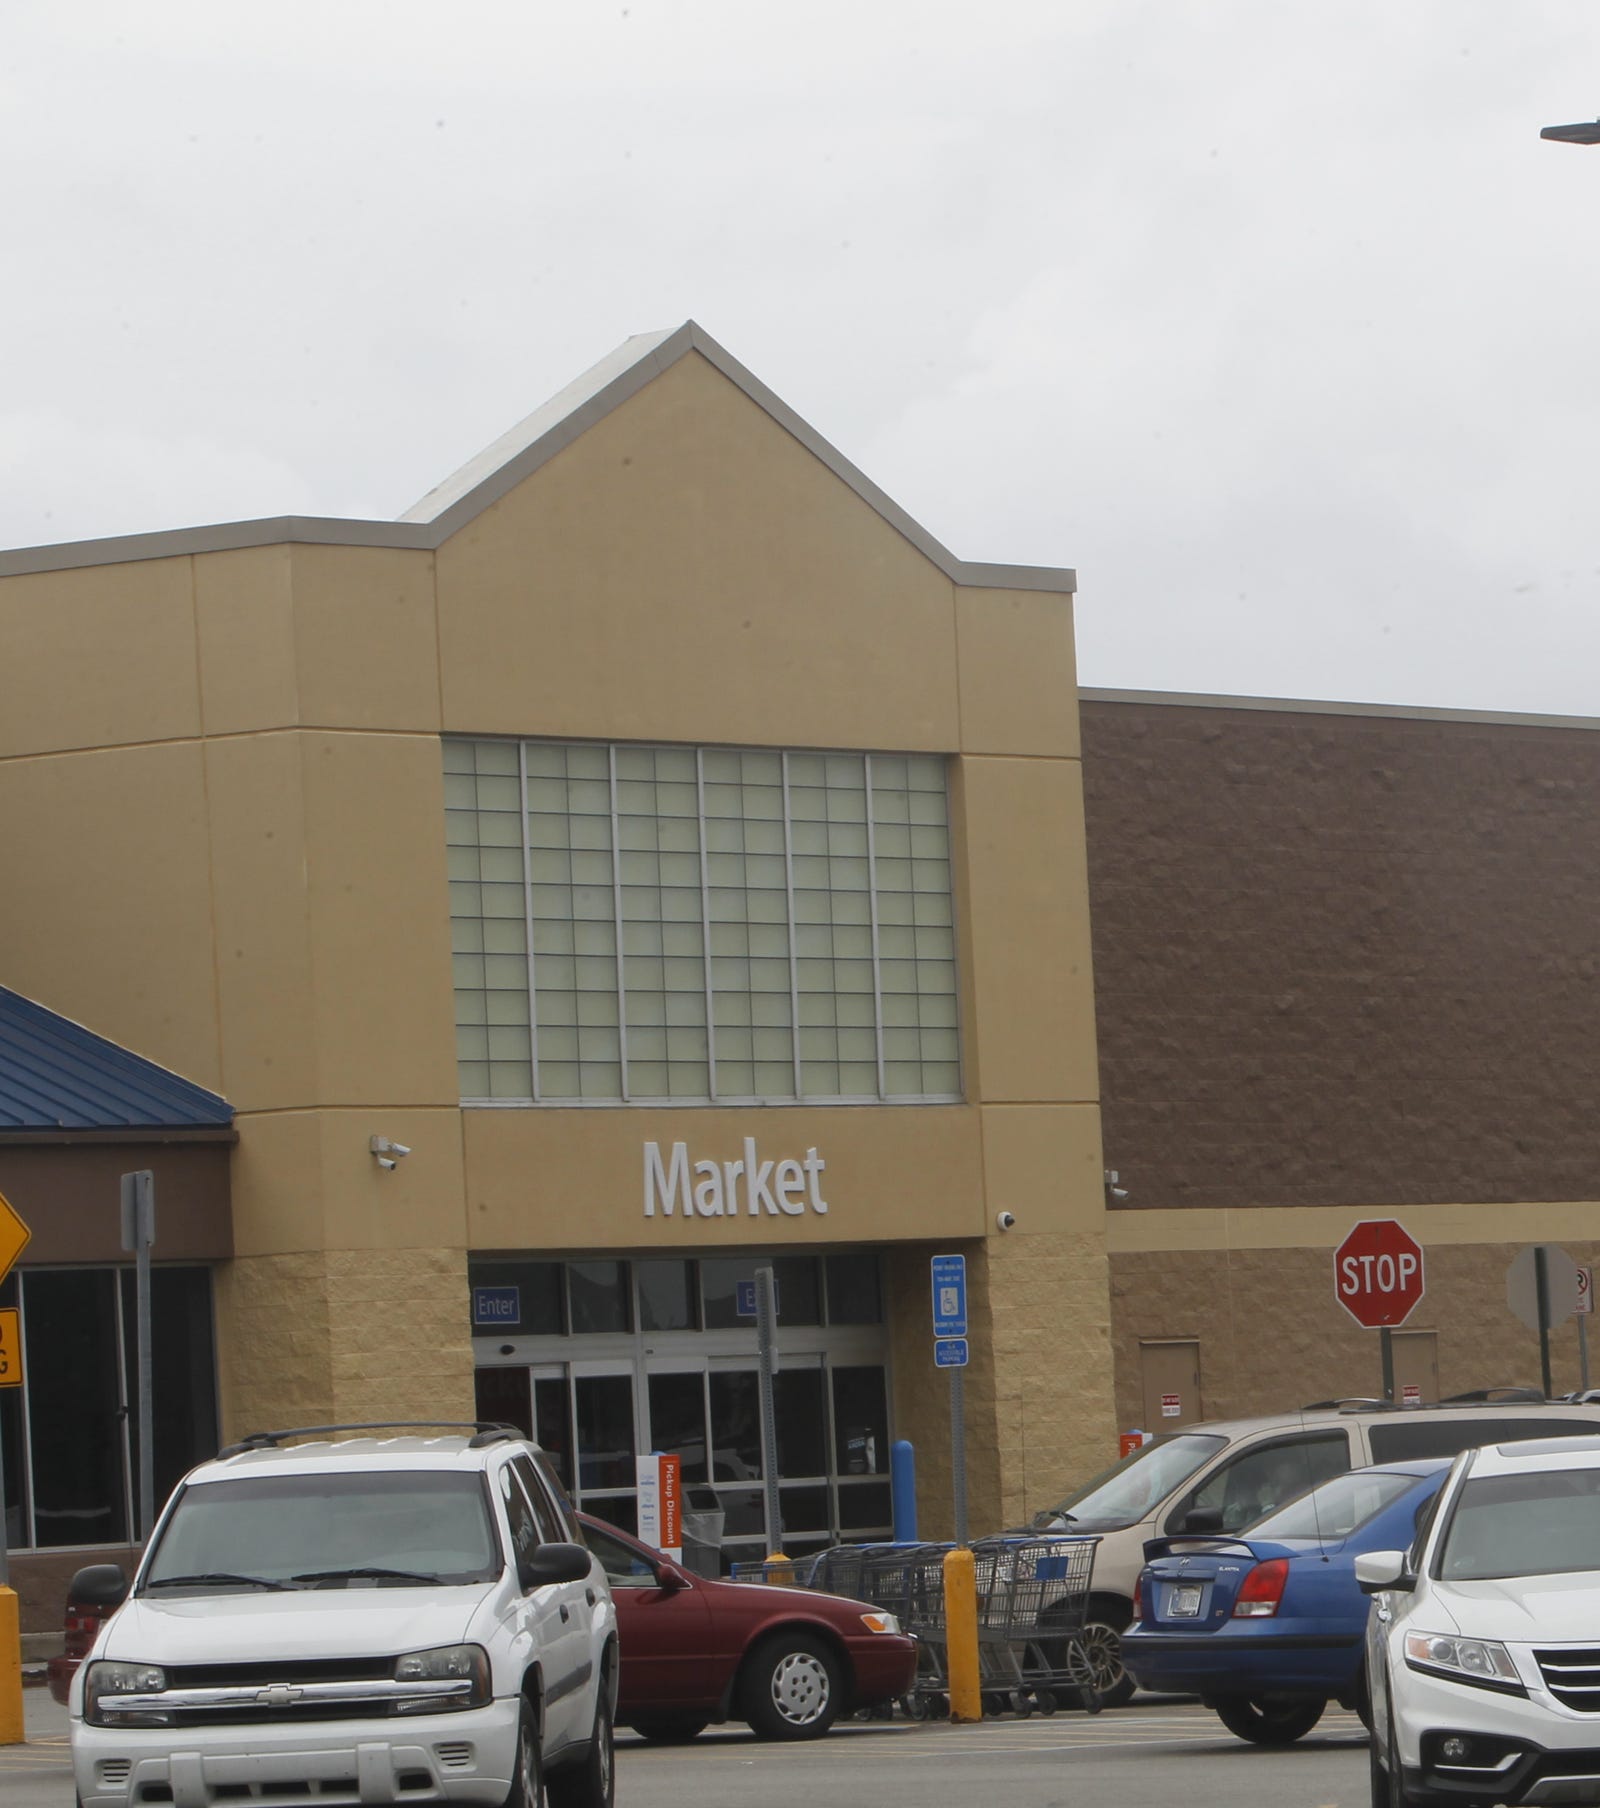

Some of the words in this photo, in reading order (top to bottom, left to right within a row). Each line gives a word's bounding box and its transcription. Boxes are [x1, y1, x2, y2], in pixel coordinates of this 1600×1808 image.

[643, 1136, 829, 1216] Market
[1342, 1253, 1417, 1295] STOP
[478, 1295, 515, 1316] Enter
[664, 1464, 675, 1498] Pickup
[666, 1501, 675, 1545] Discount
